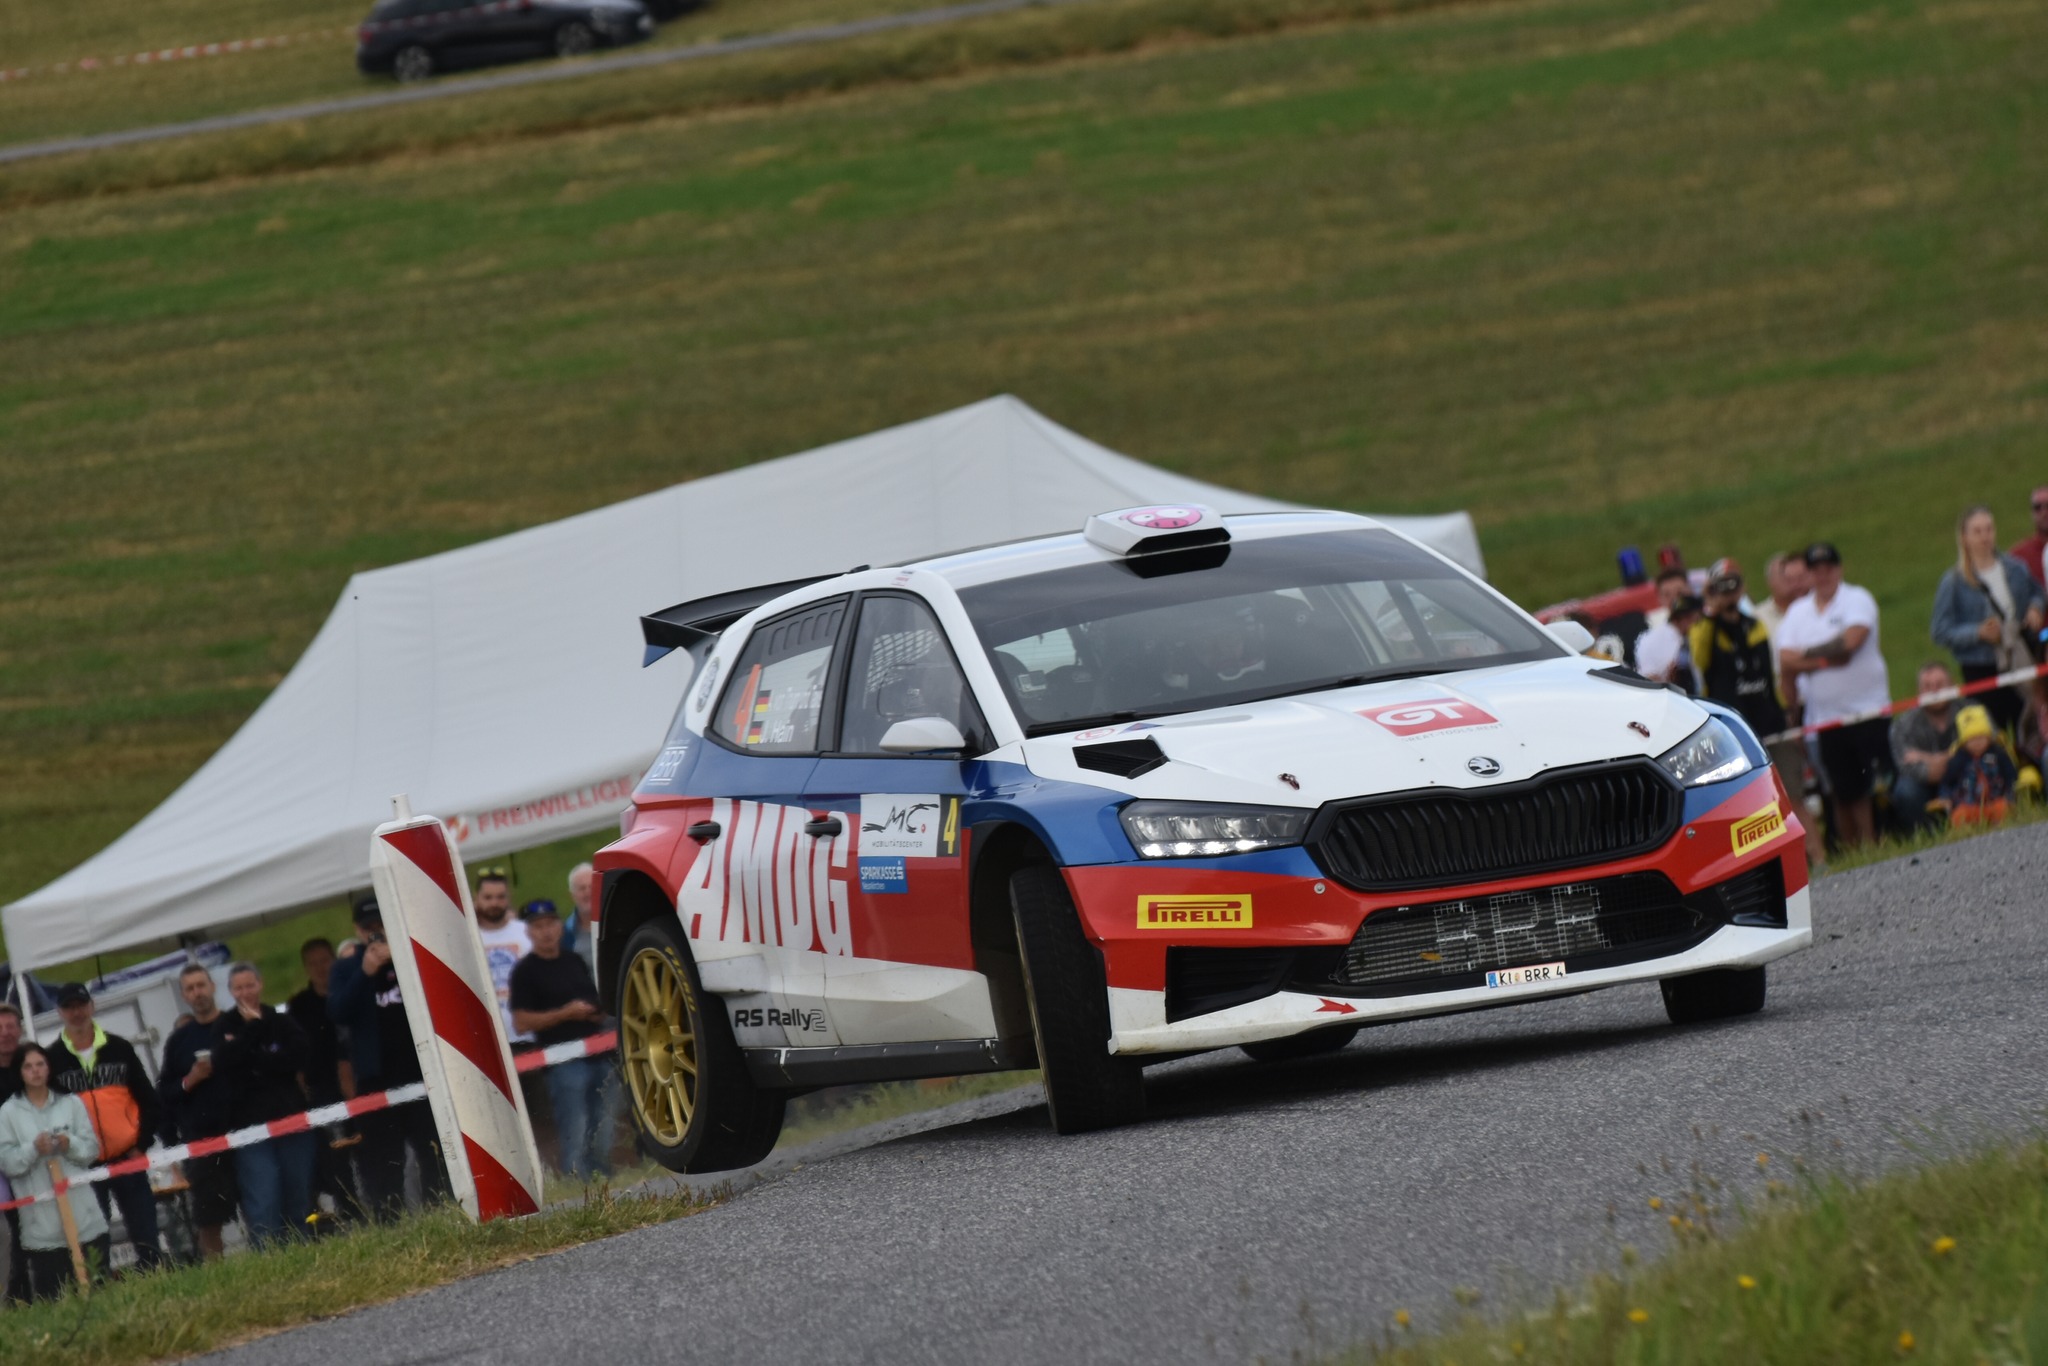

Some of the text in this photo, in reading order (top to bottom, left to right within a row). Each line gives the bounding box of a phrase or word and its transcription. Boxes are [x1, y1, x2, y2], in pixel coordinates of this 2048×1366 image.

[732, 663, 762, 746] 4
[1376, 702, 1464, 726] GT
[477, 775, 632, 834] FREIWILLIGE
[943, 798, 958, 855] 4
[1737, 810, 1779, 848] PIRELLI
[872, 838, 923, 848] MOBILITÄTSCENTER
[861, 866, 898, 880] SPARKASSE
[1148, 901, 1242, 922] PIRELLI
[1499, 965, 1563, 986] KI BRR 4
[735, 1008, 827, 1032] RS Rally2
